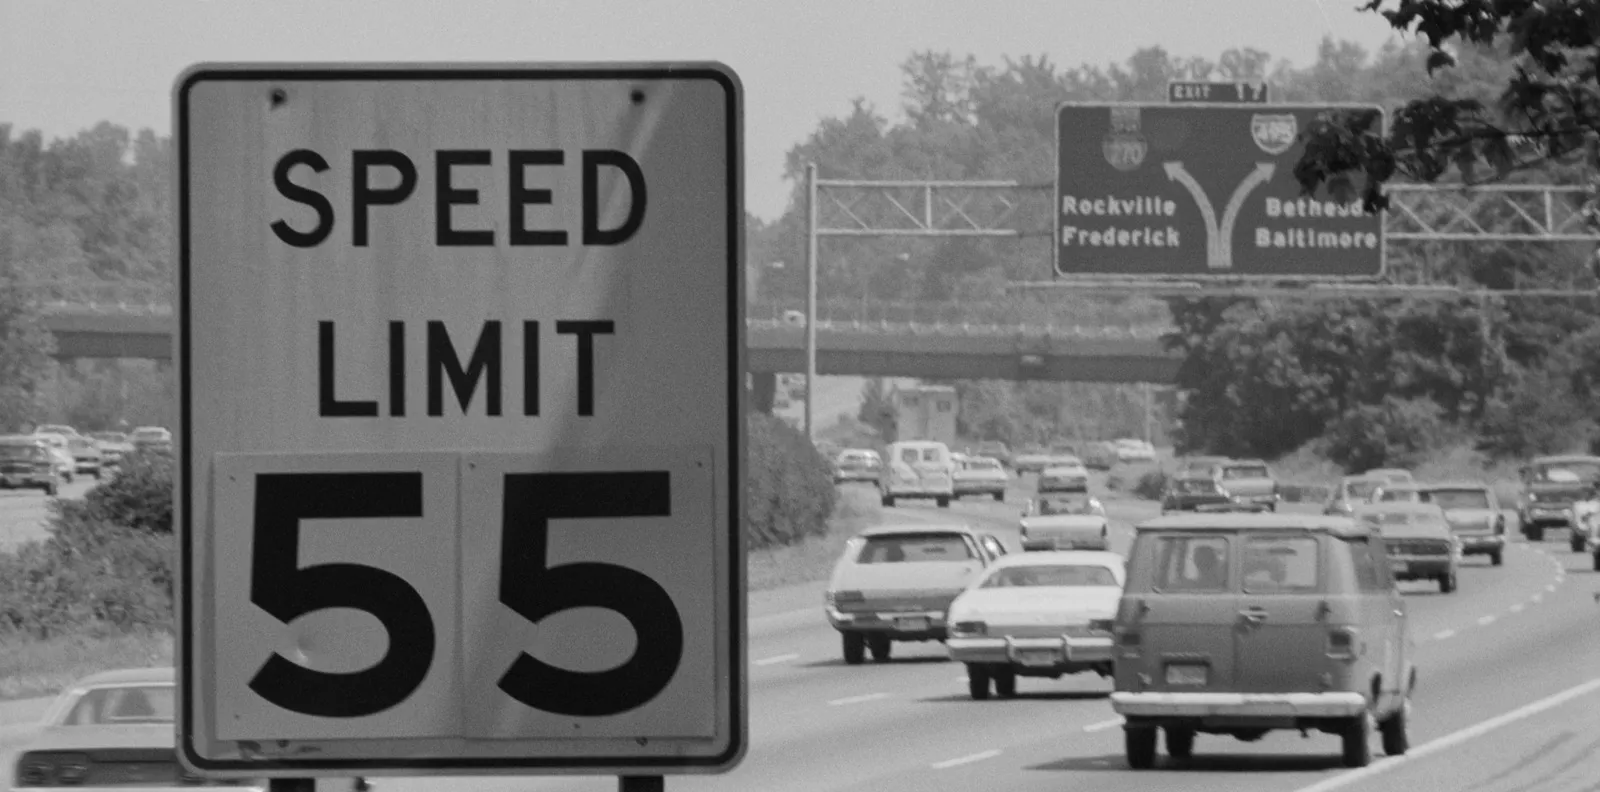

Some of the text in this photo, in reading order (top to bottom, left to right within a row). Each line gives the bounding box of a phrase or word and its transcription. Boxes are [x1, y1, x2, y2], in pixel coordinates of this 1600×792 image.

[1173, 85, 1211, 99] EXIT
[270, 149, 648, 248] SPEED
[1062, 195, 1177, 216] Rockville
[1265, 196, 1373, 217] Bethesd
[1062, 227, 1180, 248] Frederick
[1255, 227, 1378, 249] Baltimore
[318, 320, 615, 417] LIMIT
[248, 470, 684, 718] 55
